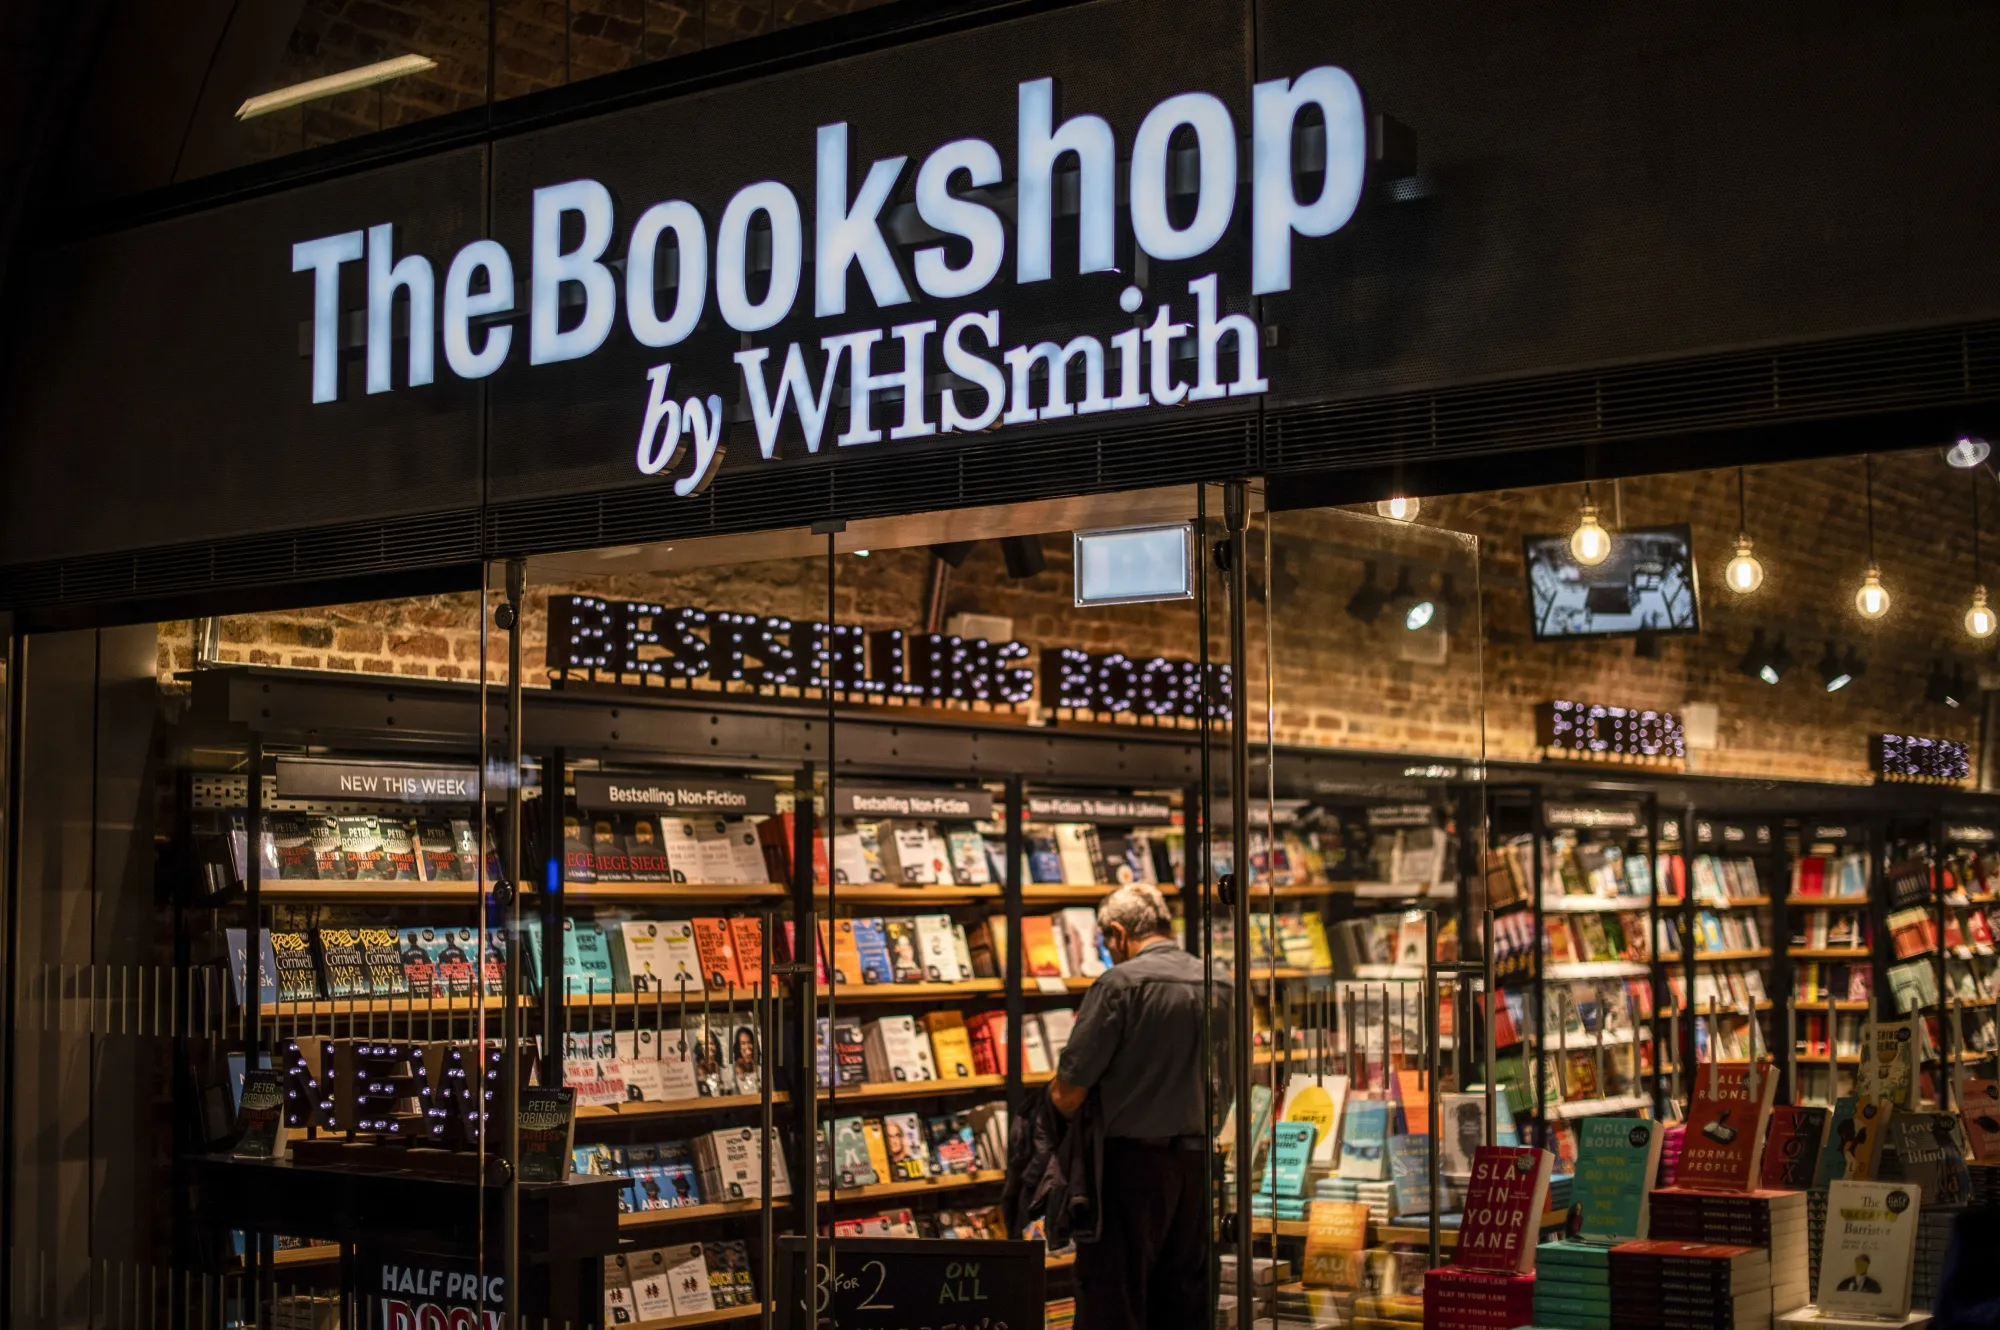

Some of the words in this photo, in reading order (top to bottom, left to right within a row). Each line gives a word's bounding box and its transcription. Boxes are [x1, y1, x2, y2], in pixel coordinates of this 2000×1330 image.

[636, 363, 722, 498] by
[734, 273, 1269, 460] WHSmith
[564, 594, 1034, 704] BESTSELLING
[1552, 699, 1687, 759] FICTION
[340, 775, 378, 792] NEW
[383, 777, 417, 794] THIS
[421, 778, 467, 796] WEEK
[609, 785, 675, 806] Bestselling
[677, 789, 747, 806] Non-Fiction
[852, 794, 909, 814] Bestselling
[909, 798, 970, 813] Non-Fiction
[348, 827, 371, 838] PETER
[387, 828, 406, 839] PETER
[341, 837, 381, 849] ROBINSON
[315, 851, 340, 861] RELESS
[347, 851, 380, 861] CARELESS
[387, 853, 415, 863] CARELESS
[427, 853, 455, 861] CARELESS
[566, 852, 595, 868] EGE
[357, 861, 374, 870] LOVE
[396, 862, 410, 871] LOVE
[435, 861, 450, 870] LOVE
[630, 856, 667, 871] SIEGE
[276, 955, 313, 970] Cornwell
[326, 950, 362, 966] Cornwell
[365, 949, 400, 966] Cornwell
[280, 970, 306, 980] WAR
[330, 965, 355, 977] WAR
[369, 965, 395, 977] WAR
[252, 1082, 276, 1093] PETER
[286, 1042, 502, 1142] NEW
[243, 1092, 283, 1105] ROBINSON
[528, 1100, 557, 1112] PETER
[1593, 1123, 1636, 1135] HOLL
[1901, 1122, 1934, 1135] Love
[1904, 1136, 1917, 1148] is
[727, 1153, 748, 1161] RIGHT
[1687, 1148, 1743, 1161] NORMAL
[1907, 1149, 1946, 1164] Blind
[1688, 1162, 1739, 1174] PEOPLE
[1487, 1187, 1509, 1204] IN
[1861, 1196, 1880, 1208] The
[1467, 1208, 1524, 1226] YOUR
[1844, 1222, 1893, 1236] Barrister
[1462, 1232, 1518, 1250] LANE
[945, 1262, 980, 1279] ON
[382, 1265, 443, 1296] HALF
[446, 1272, 505, 1303] PRIC
[800, 1263, 830, 1313] 3
[834, 1273, 860, 1292] FOR
[855, 1260, 895, 1310] 2
[938, 1279, 988, 1305] ALL
